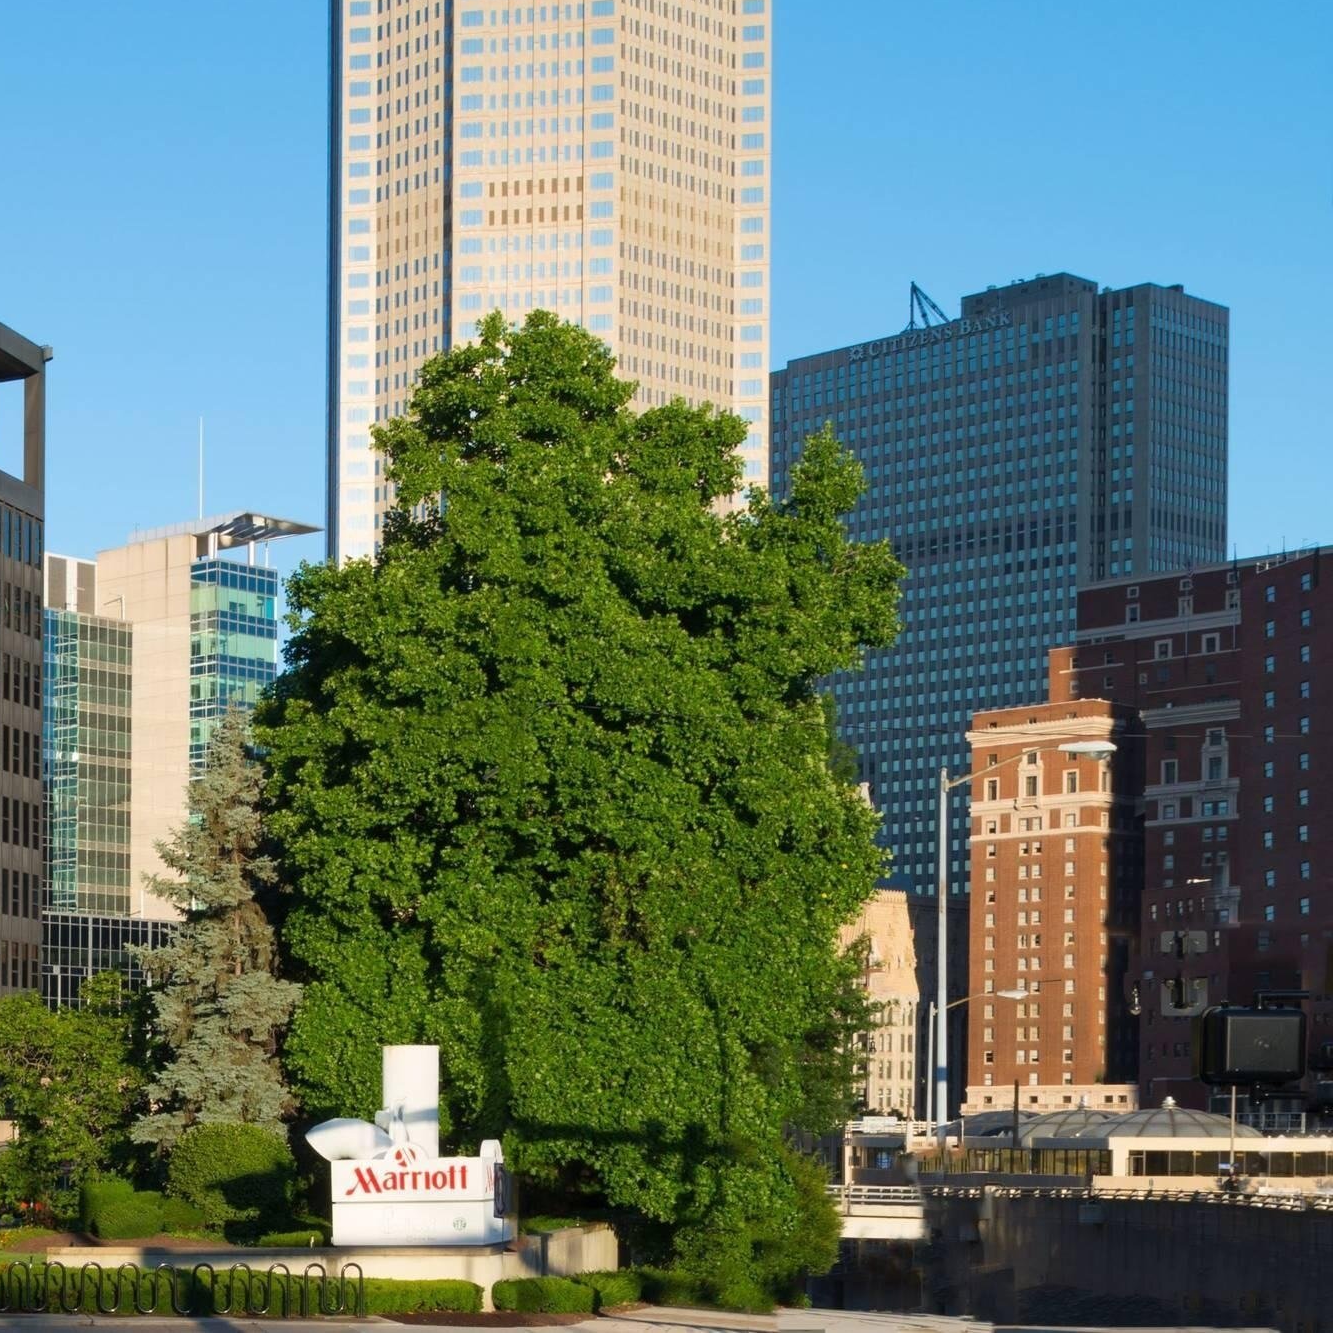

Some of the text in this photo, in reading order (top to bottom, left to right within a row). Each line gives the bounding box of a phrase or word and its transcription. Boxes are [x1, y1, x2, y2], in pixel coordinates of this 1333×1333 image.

[868, 312, 1013, 357] CITIZENS BANK
[344, 1164, 468, 1196] Marriott
